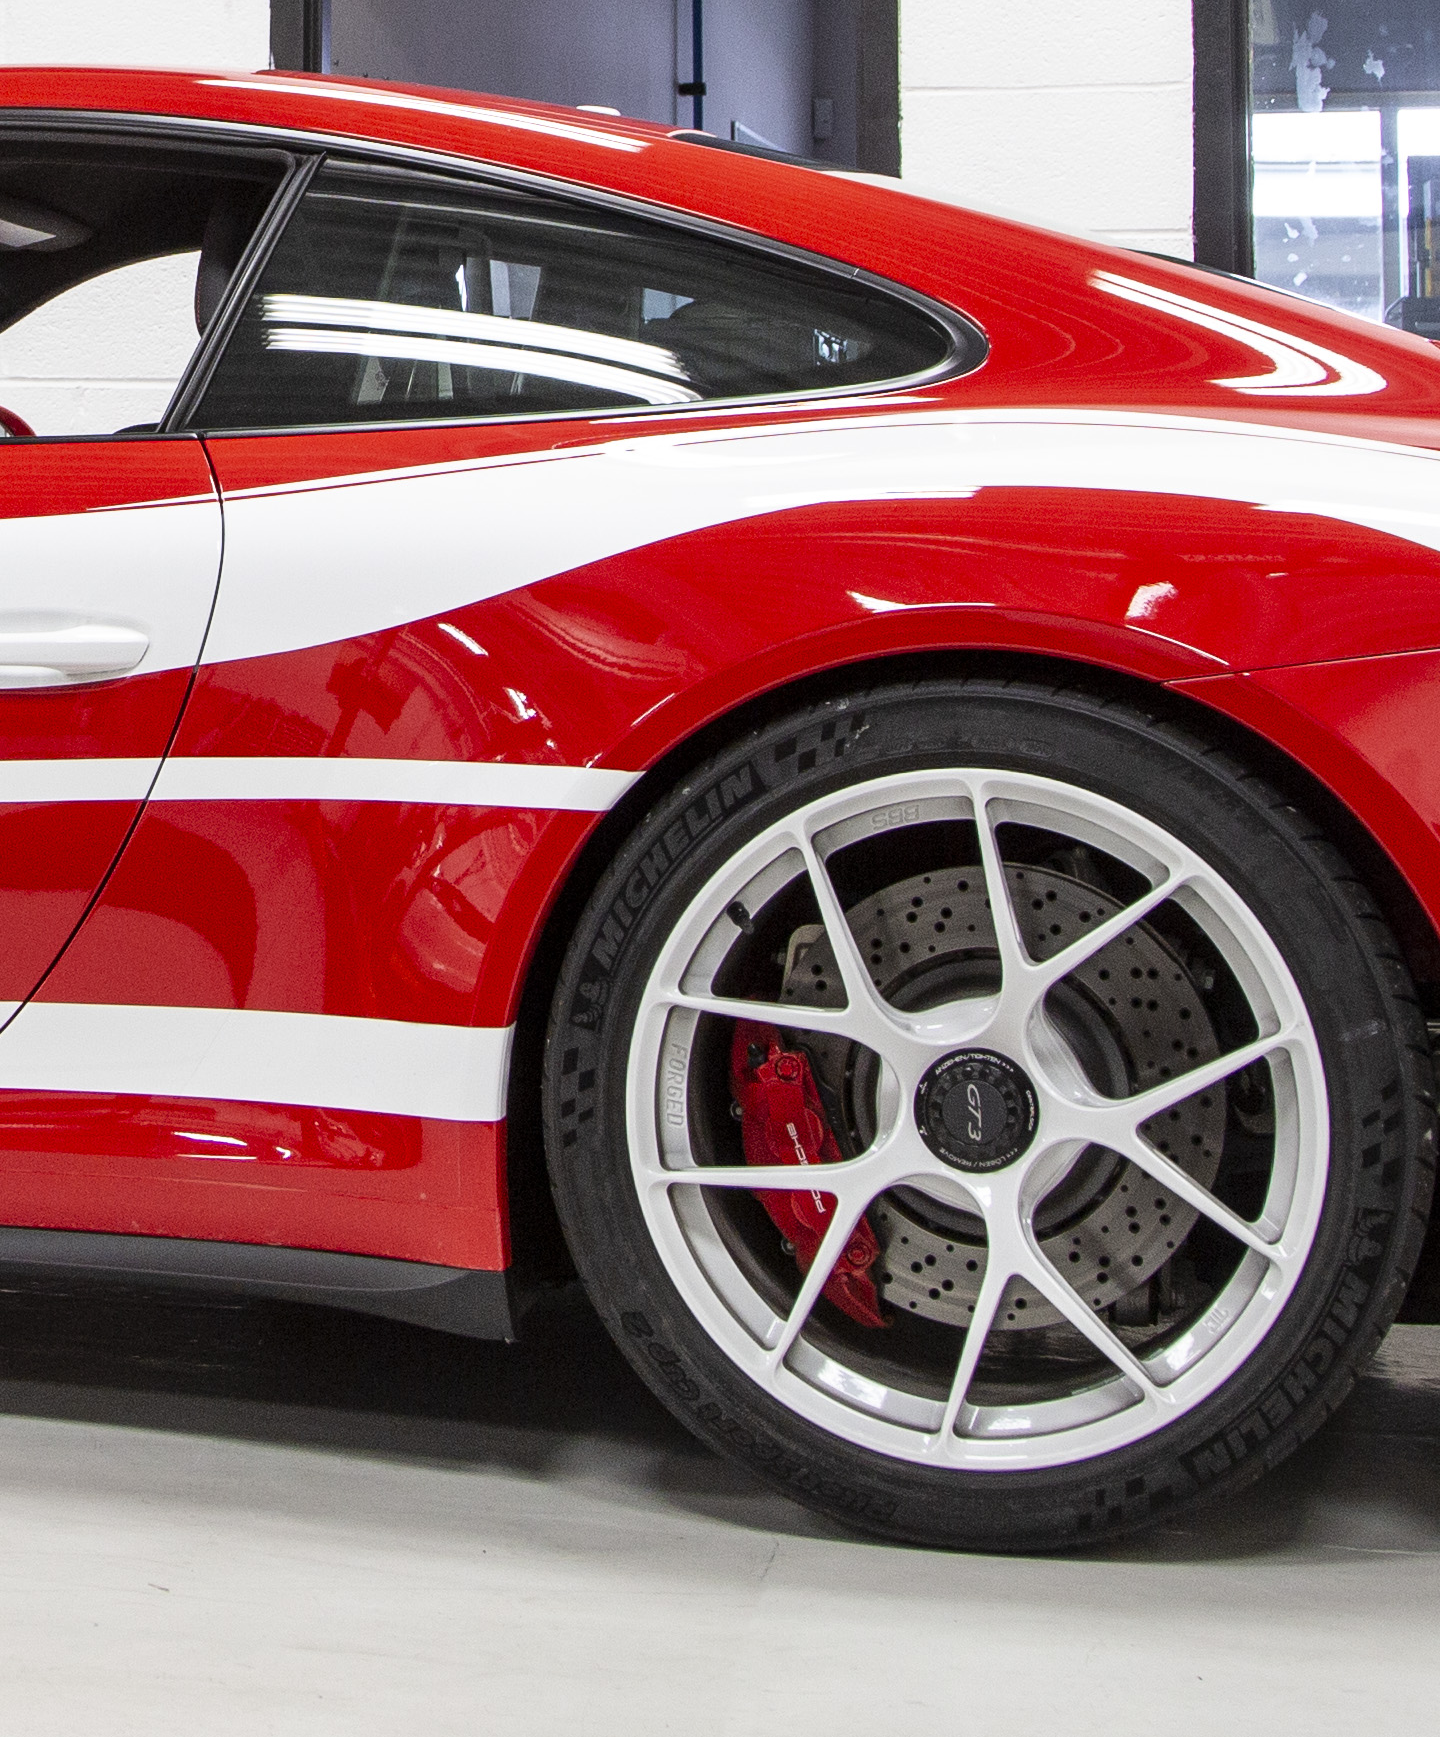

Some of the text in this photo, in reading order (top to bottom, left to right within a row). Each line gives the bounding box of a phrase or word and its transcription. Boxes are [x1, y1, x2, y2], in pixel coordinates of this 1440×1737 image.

[871, 804, 920, 831] BBS
[591, 763, 754, 971] MICHELIN
[666, 1043, 689, 1127] FORGED
[785, 1122, 826, 1214] POCHE
[1192, 1270, 1370, 1480] MICHELIN
